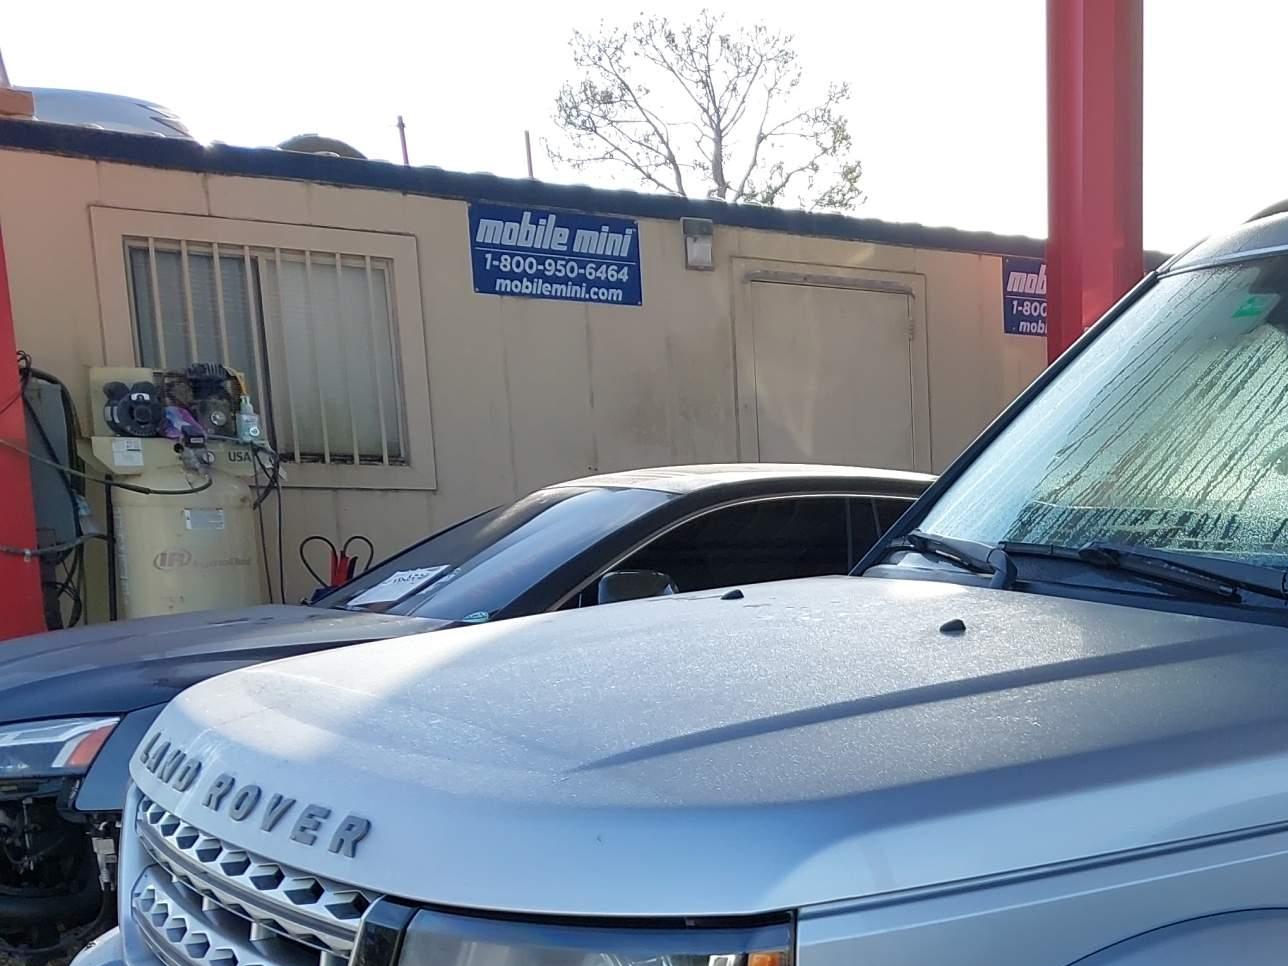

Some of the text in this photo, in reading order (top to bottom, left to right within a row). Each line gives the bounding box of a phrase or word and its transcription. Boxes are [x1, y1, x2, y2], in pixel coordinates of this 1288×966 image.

[476, 211, 633, 257] mobile mini
[485, 254, 629, 282] 1-800-950-6464
[495, 277, 623, 301] mobilemini.com
[228, 451, 251, 463] USA
[140, 731, 372, 858] LAND ROVER
